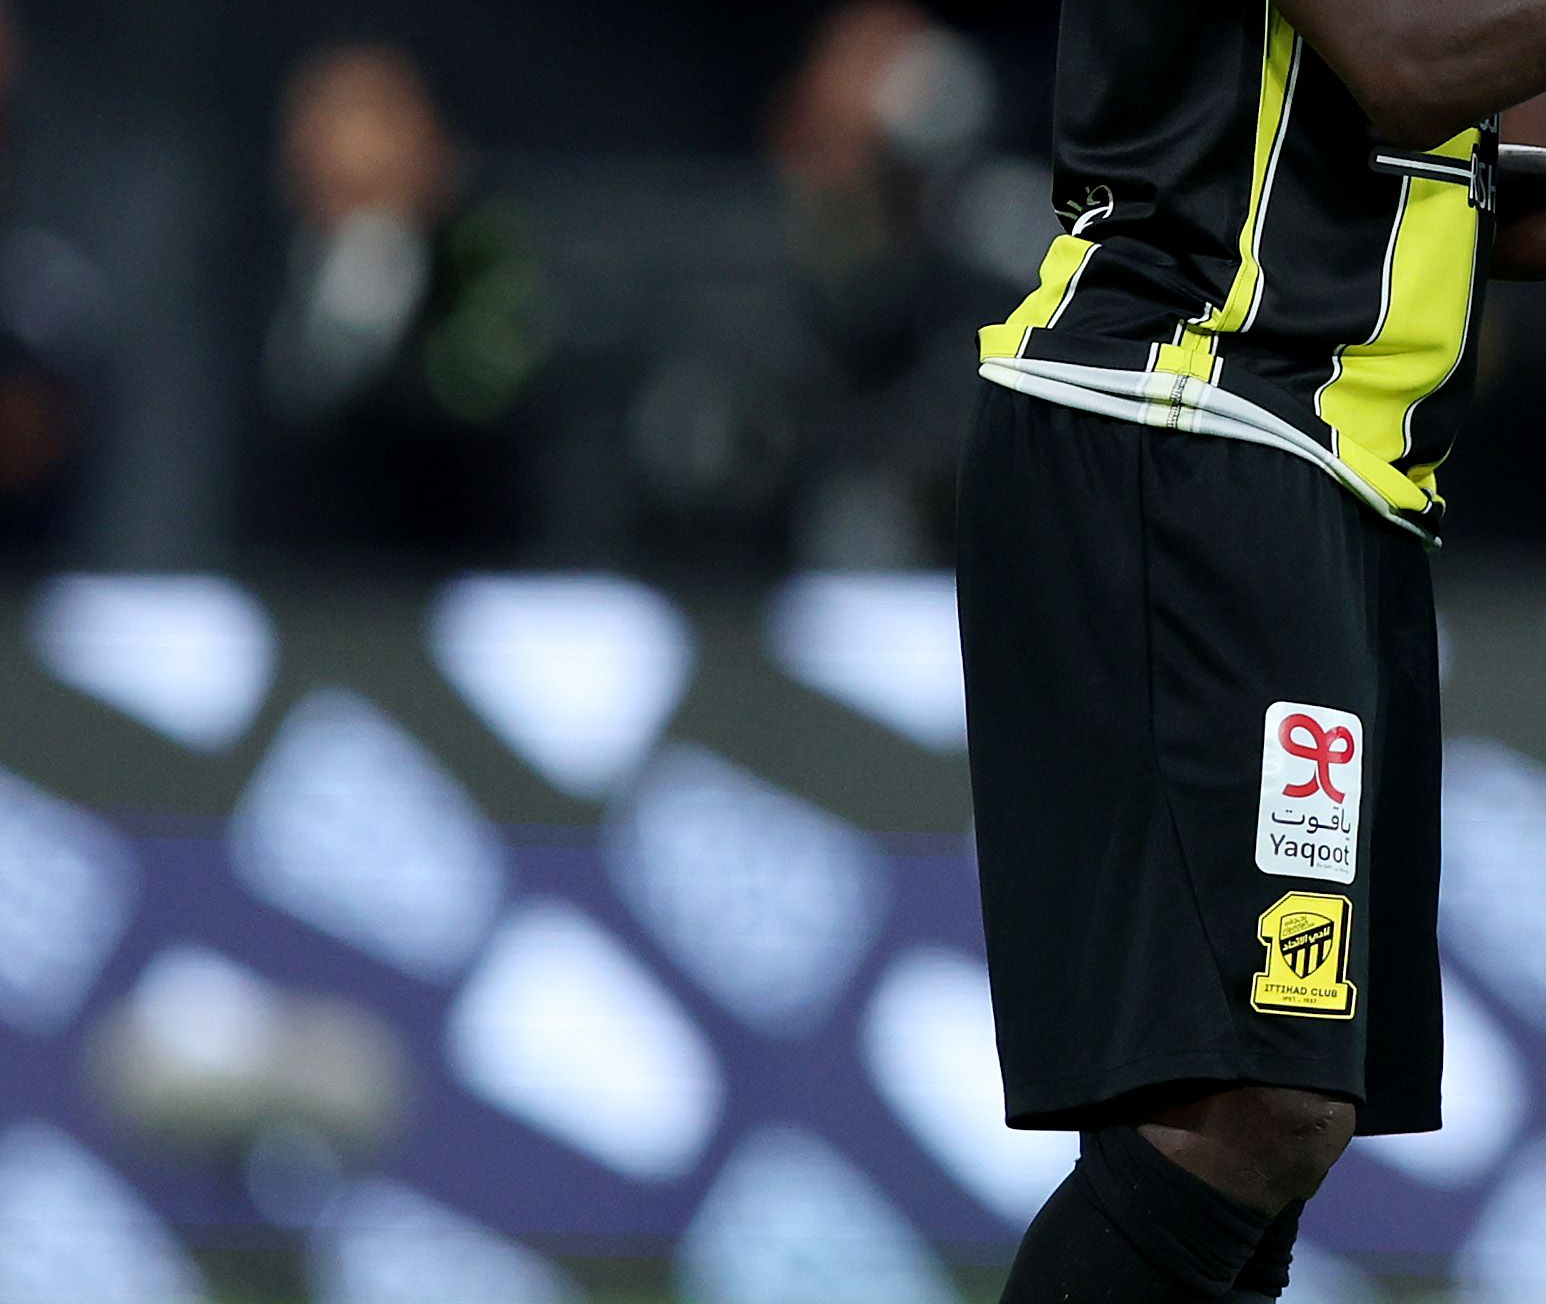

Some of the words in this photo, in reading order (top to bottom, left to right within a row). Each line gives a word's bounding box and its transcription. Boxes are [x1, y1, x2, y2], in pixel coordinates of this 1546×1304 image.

[1271, 801, 1351, 841] ياقوت
[1269, 832, 1350, 867] Yaqoot
[1264, 983, 1308, 996] ITTIHAD
[1310, 988, 1338, 998] CLUB
